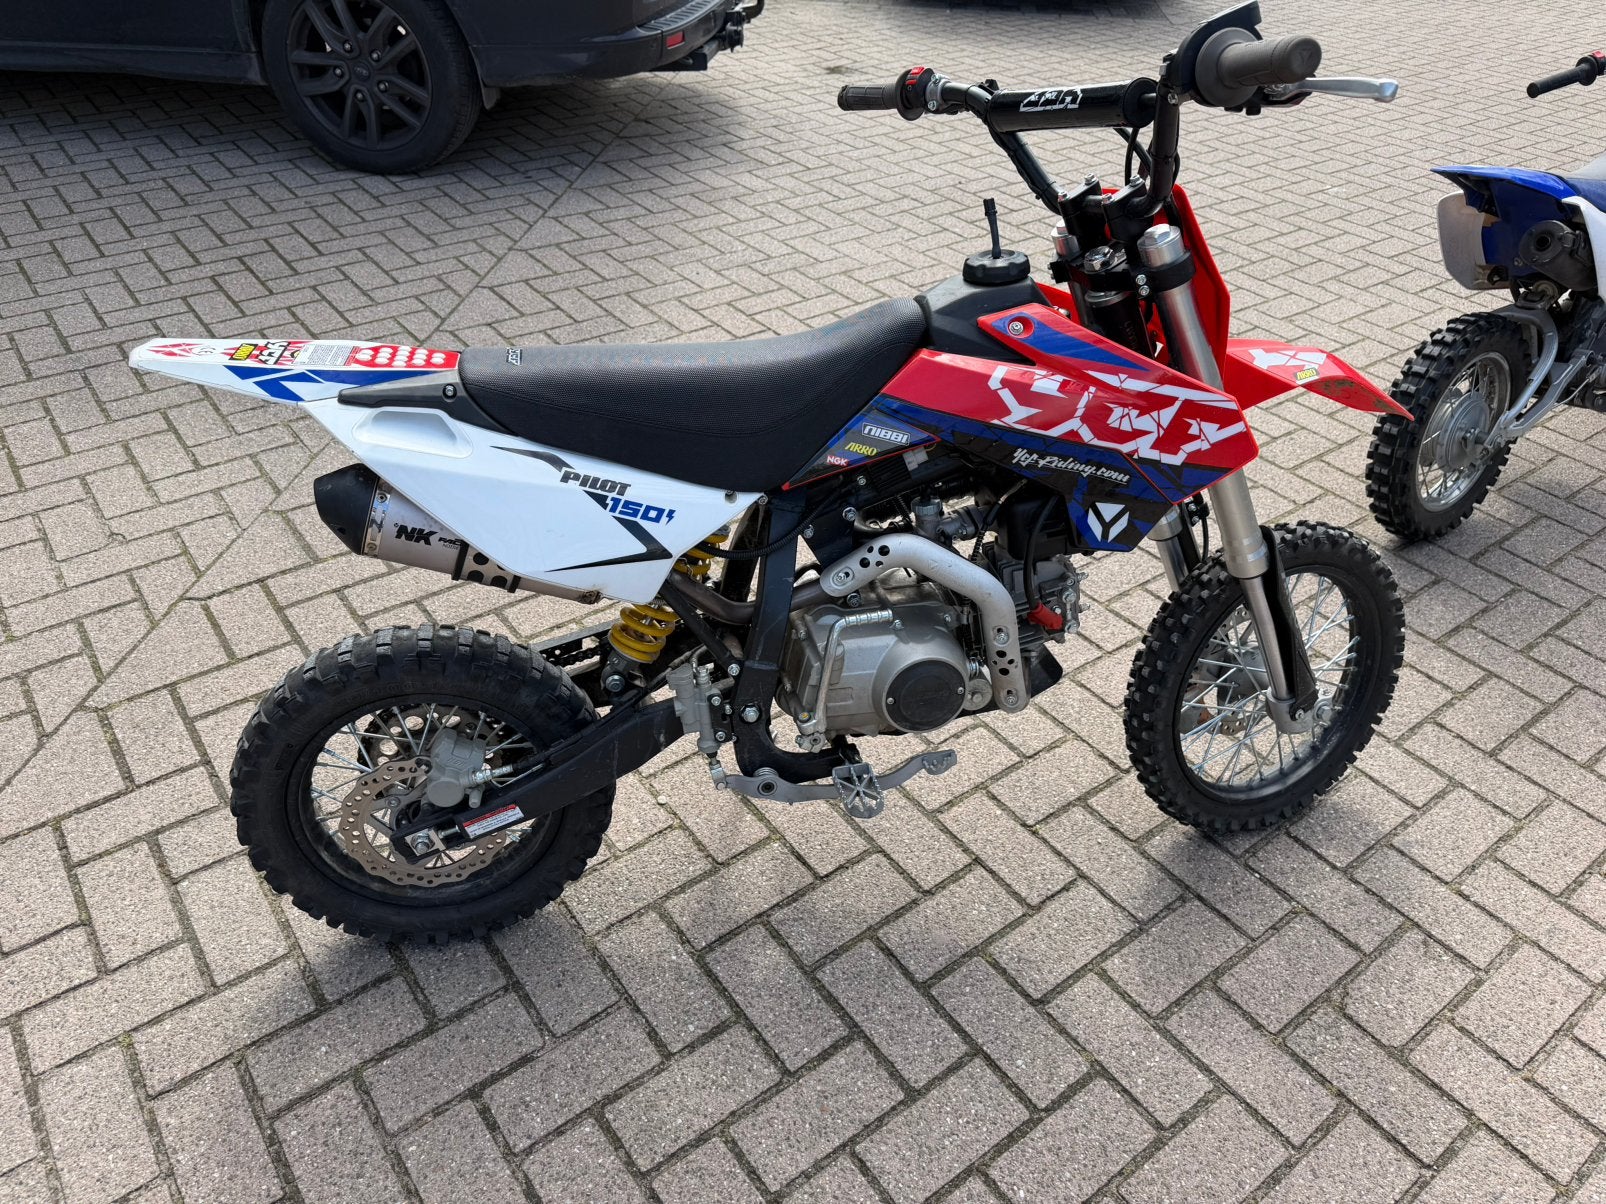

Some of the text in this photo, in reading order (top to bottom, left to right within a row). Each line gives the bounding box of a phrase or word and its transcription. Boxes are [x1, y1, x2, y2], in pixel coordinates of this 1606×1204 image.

[863, 425, 909, 444] NIBBI
[844, 442, 878, 457] ARRO
[826, 455, 849, 466] NGK
[560, 470, 631, 496] PILOT
[608, 496, 666, 524] 150
[394, 524, 438, 546] NK
